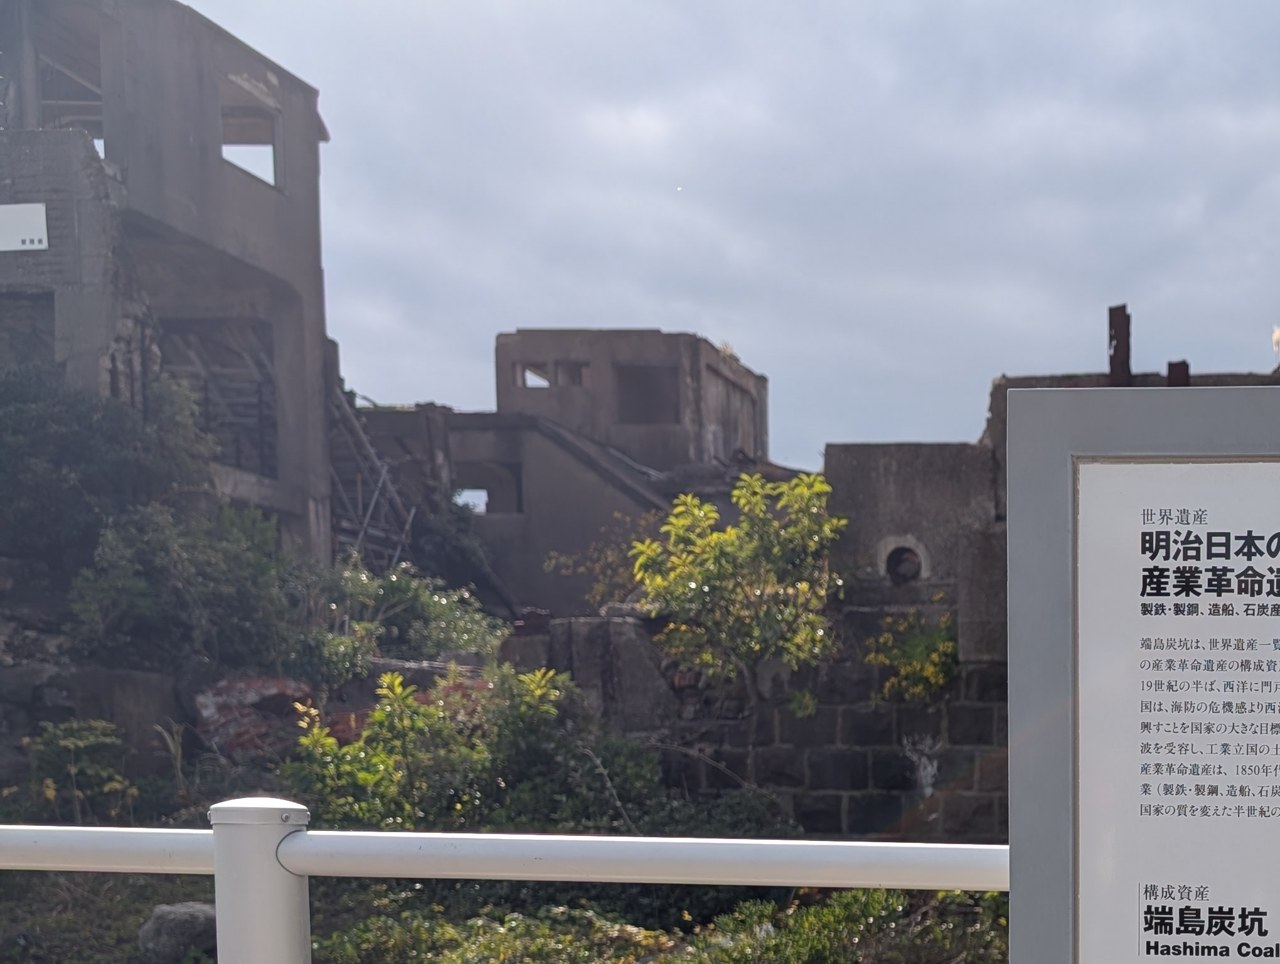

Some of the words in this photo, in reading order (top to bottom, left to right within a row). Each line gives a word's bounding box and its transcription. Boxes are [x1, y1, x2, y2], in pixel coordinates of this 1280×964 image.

[1141, 508, 1208, 525] 世界遺産
[1143, 884, 1209, 901] 構成資産
[1143, 905, 1268, 937] 端島炭坑
[1146, 941, 1229, 957] Hashima
[1237, 942, 1280, 957] Coal
